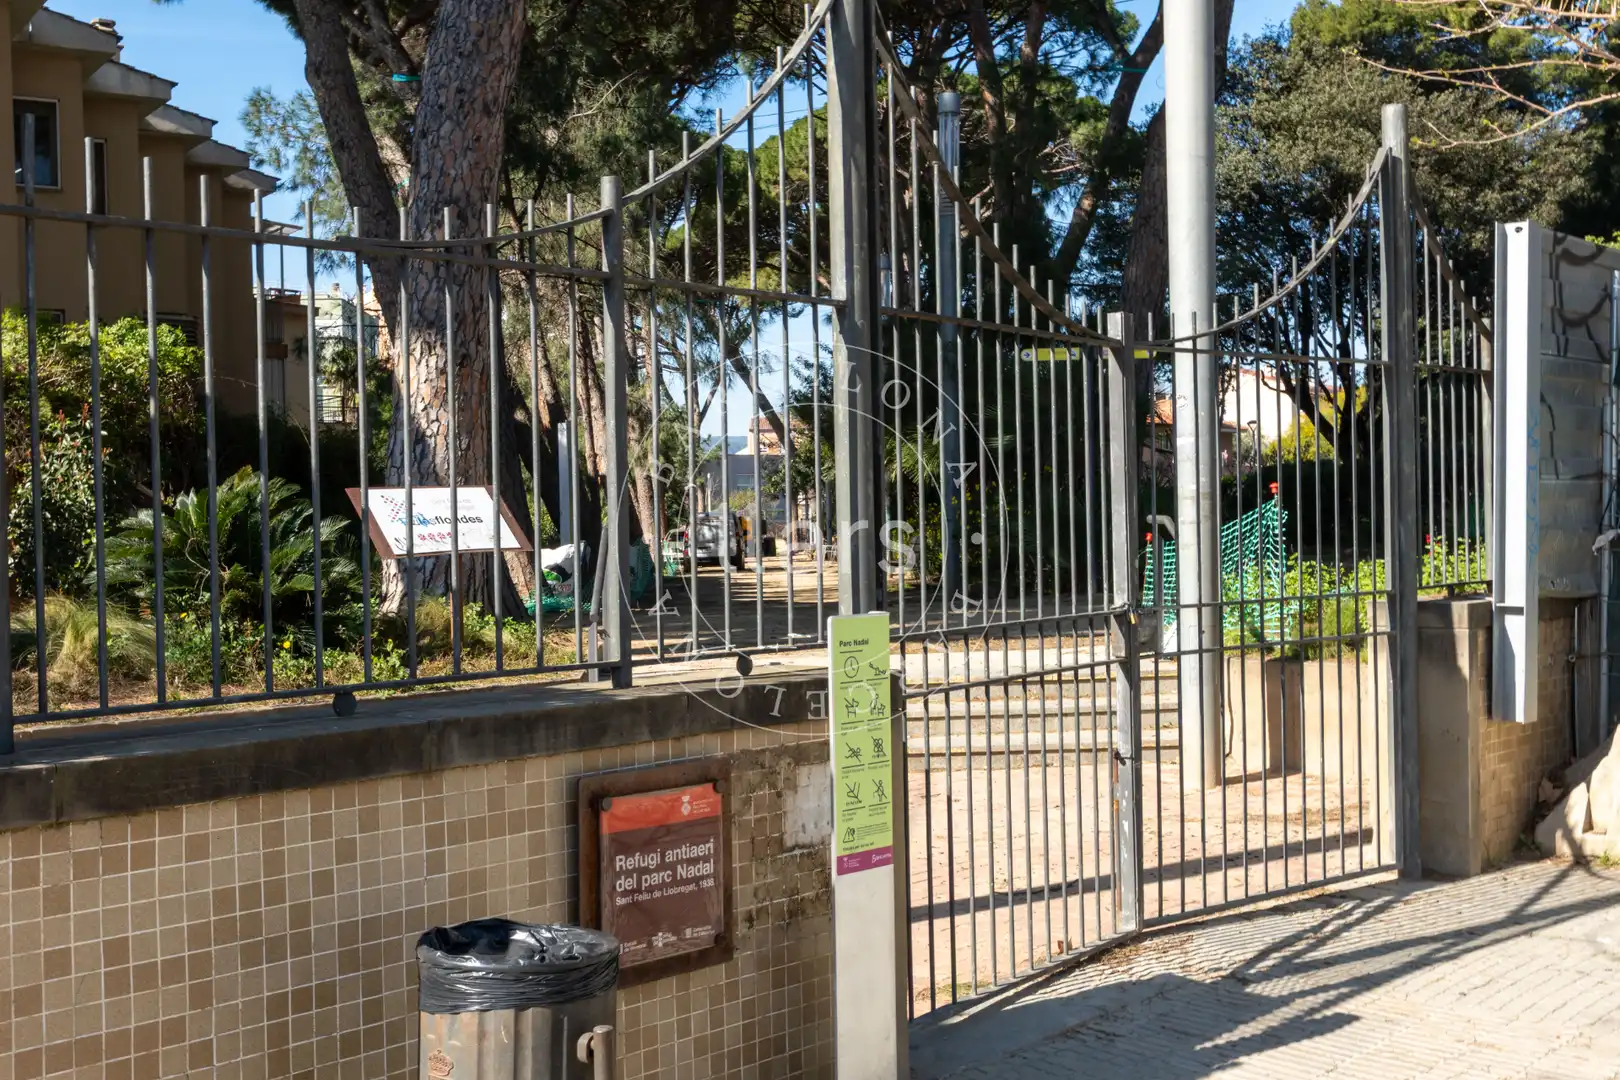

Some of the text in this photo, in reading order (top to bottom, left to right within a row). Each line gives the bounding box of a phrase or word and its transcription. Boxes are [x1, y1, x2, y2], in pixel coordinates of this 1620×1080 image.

[839, 637, 869, 648] Parc Nadal
[615, 838, 714, 872] Refugi antiaeri
[615, 857, 714, 892] del parc Nadal
[615, 894, 633, 906] Sant
[633, 890, 651, 903] Feliu
[652, 889, 662, 898] de
